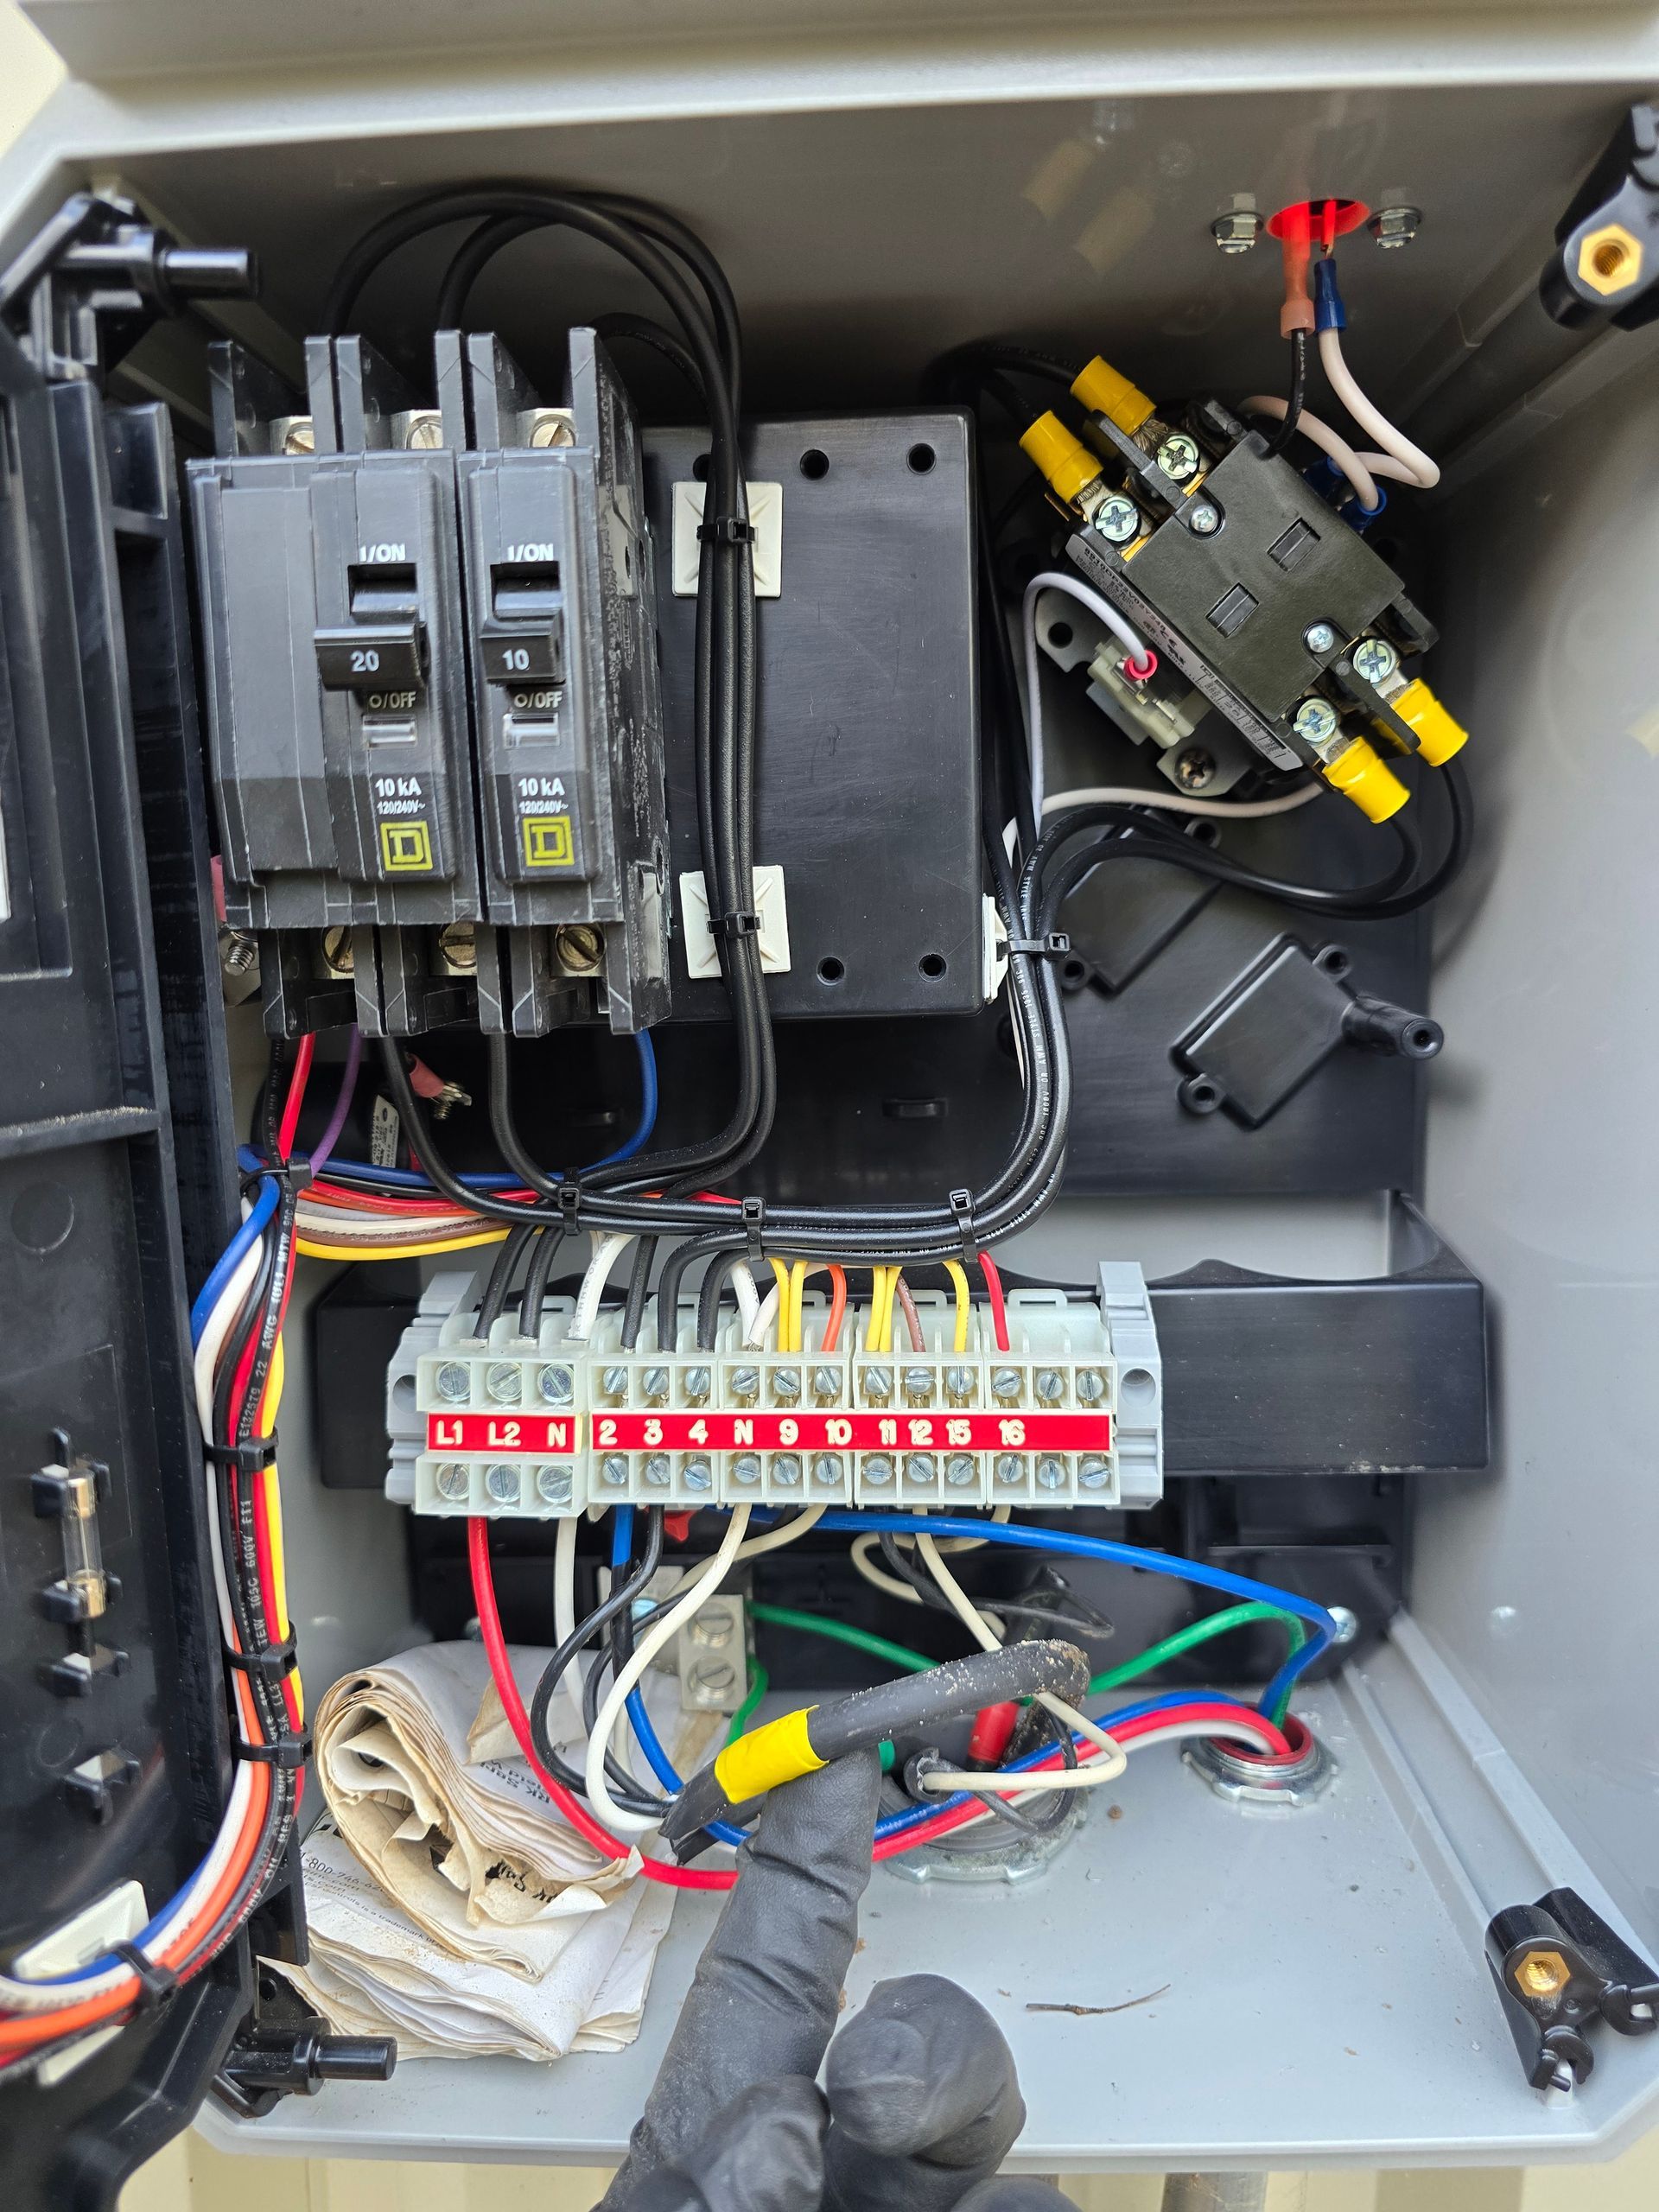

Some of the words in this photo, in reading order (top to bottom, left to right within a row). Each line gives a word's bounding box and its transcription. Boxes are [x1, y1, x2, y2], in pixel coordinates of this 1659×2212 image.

[351, 650, 380, 672] 20
[502, 649, 530, 671] 10
[375, 778, 395, 798] 10
[397, 777, 422, 797] kA
[518, 778, 538, 797] 10
[541, 778, 565, 797] kA
[1027, 1014, 1040, 1038] STYLE
[1035, 1045, 1046, 1065] AWM
[255, 1361, 268, 1377] 22
[262, 1314, 277, 1350] AWG
[277, 1232, 290, 1262] MTW
[435, 1420, 463, 1445] L1
[488, 1421, 521, 1446] L2
[548, 1422, 567, 1446] N
[598, 1420, 618, 1446] 2
[643, 1418, 664, 1446] 3
[688, 1419, 709, 1445] 4
[734, 1419, 754, 1446] N
[779, 1419, 799, 1446] 9
[824, 1418, 853, 1446] 10
[878, 1419, 897, 1446] 11
[908, 1419, 933, 1446] 12
[945, 1419, 971, 1446] 15
[998, 1418, 1026, 1446] 16
[240, 1499, 252, 1524] FT1
[243, 1535, 255, 1568] 600V
[253, 1618, 268, 1646] TEW
[378, 1912, 425, 1939] trademark
